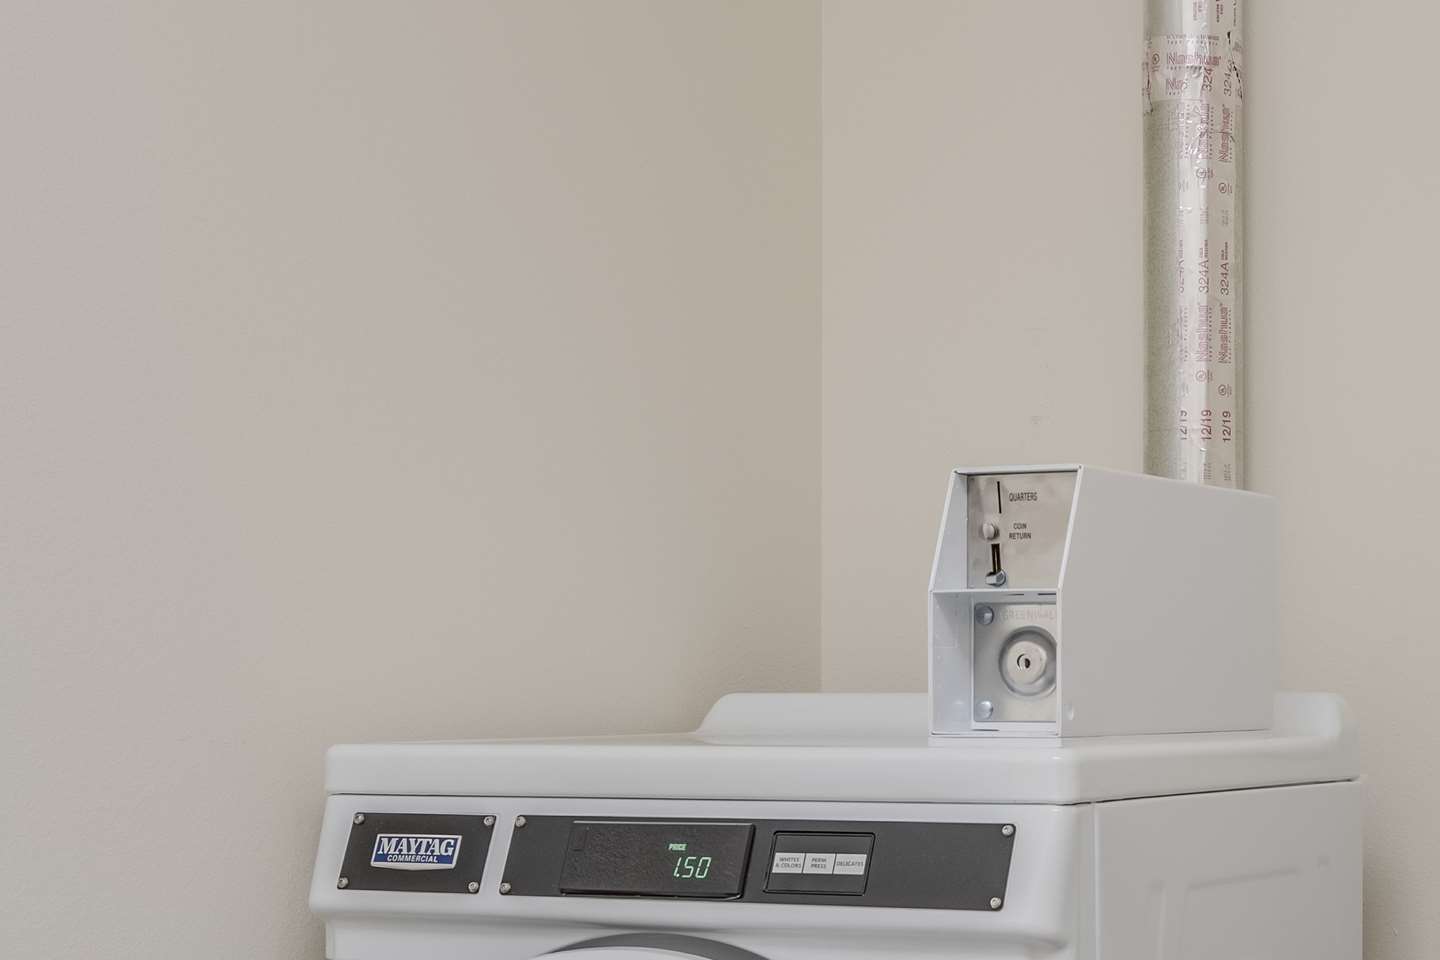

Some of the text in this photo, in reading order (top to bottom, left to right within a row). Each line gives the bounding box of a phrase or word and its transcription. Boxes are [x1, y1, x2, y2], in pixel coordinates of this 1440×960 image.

[1220, 261, 1229, 295] 324A
[1200, 409, 1212, 442] 12/19
[1222, 410, 1232, 443] 12/19
[1008, 491, 1037, 502] QUARTERS
[1013, 522, 1027, 530] COIN
[1008, 532, 1032, 541] RETURN
[377, 837, 455, 856] MAYTAG
[387, 854, 438, 863] COMMERCIAL
[673, 856, 712, 878] 1.50
